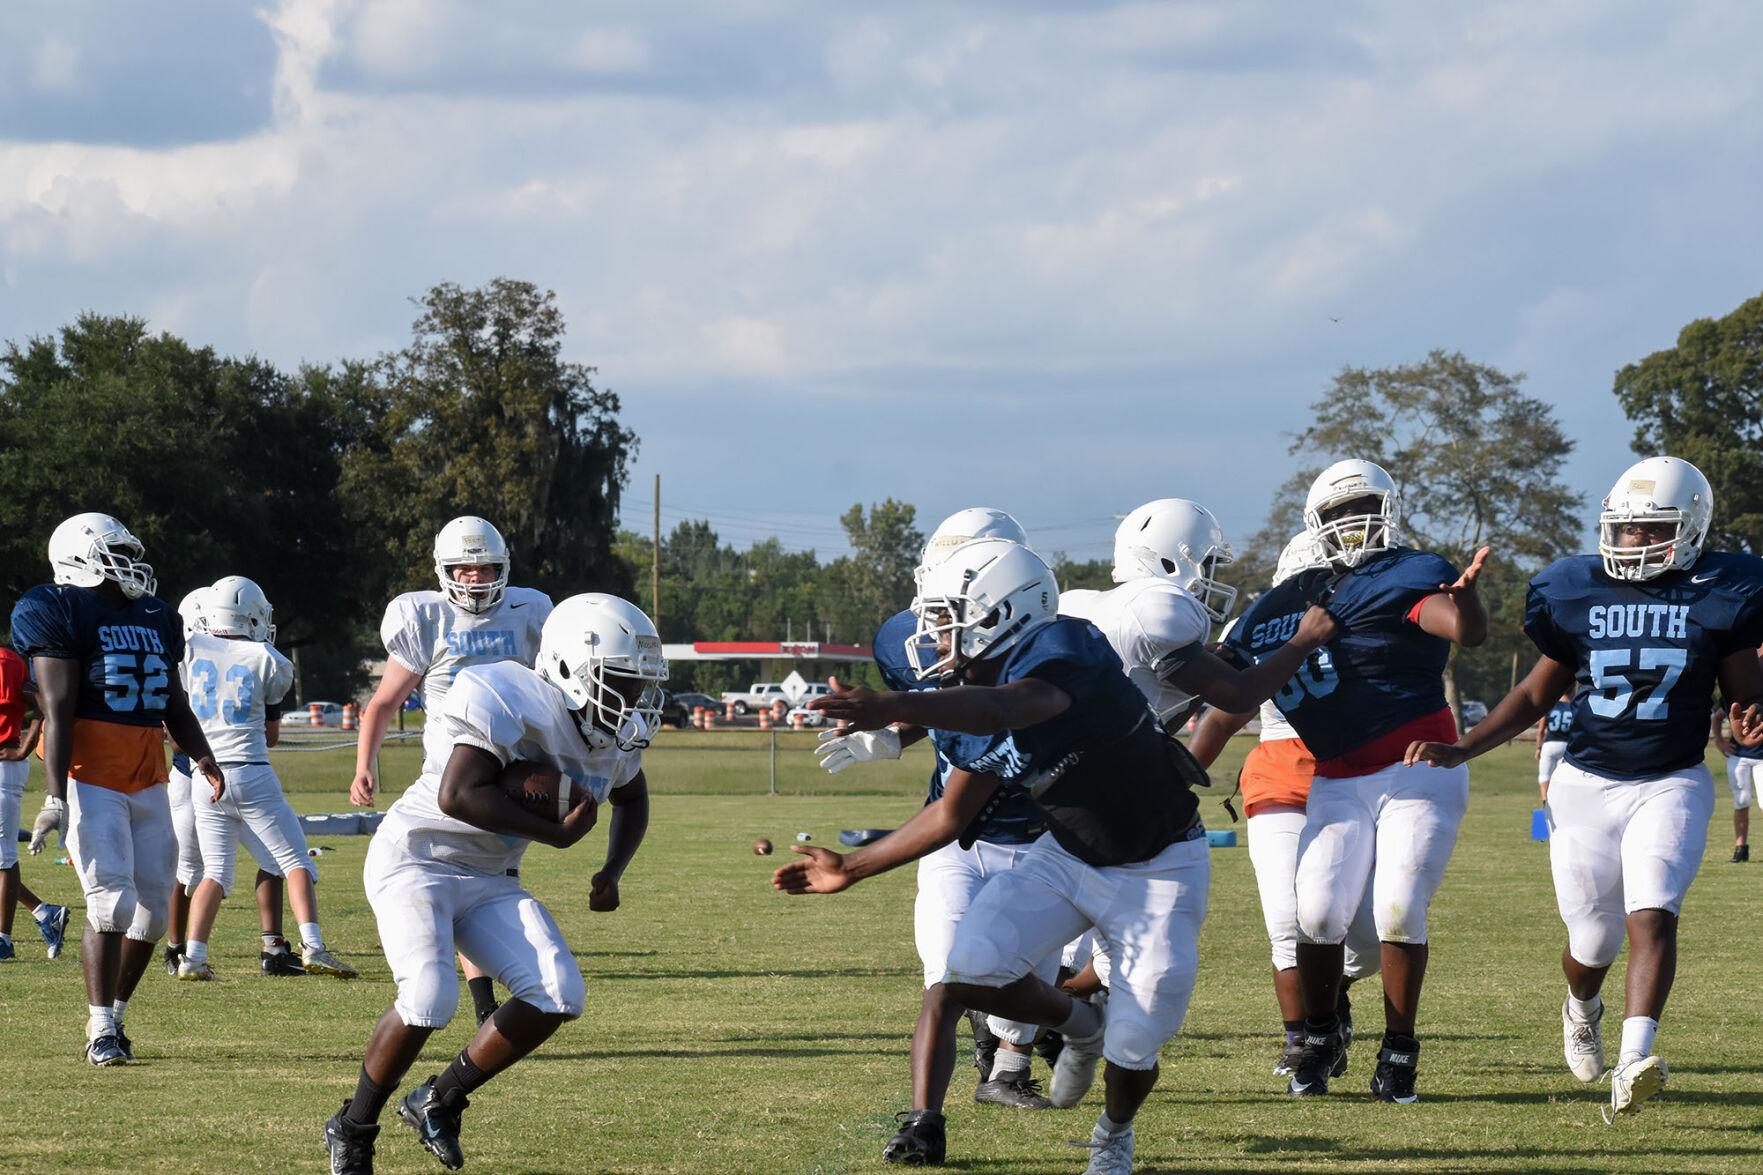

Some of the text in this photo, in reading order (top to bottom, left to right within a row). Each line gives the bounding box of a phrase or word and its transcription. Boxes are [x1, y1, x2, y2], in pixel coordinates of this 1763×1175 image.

[1250, 611, 1305, 649] SOU
[1589, 604, 1689, 638] SOUTH
[98, 626, 164, 653] SOUTH
[447, 630, 518, 656] SOUTH
[104, 653, 170, 711] 52
[191, 658, 253, 723] 33
[1588, 648, 1687, 719] 57
[1548, 709, 1573, 732] 35
[1306, 1035, 1326, 1046] NIKE
[1389, 1053, 1410, 1064] NIKE
